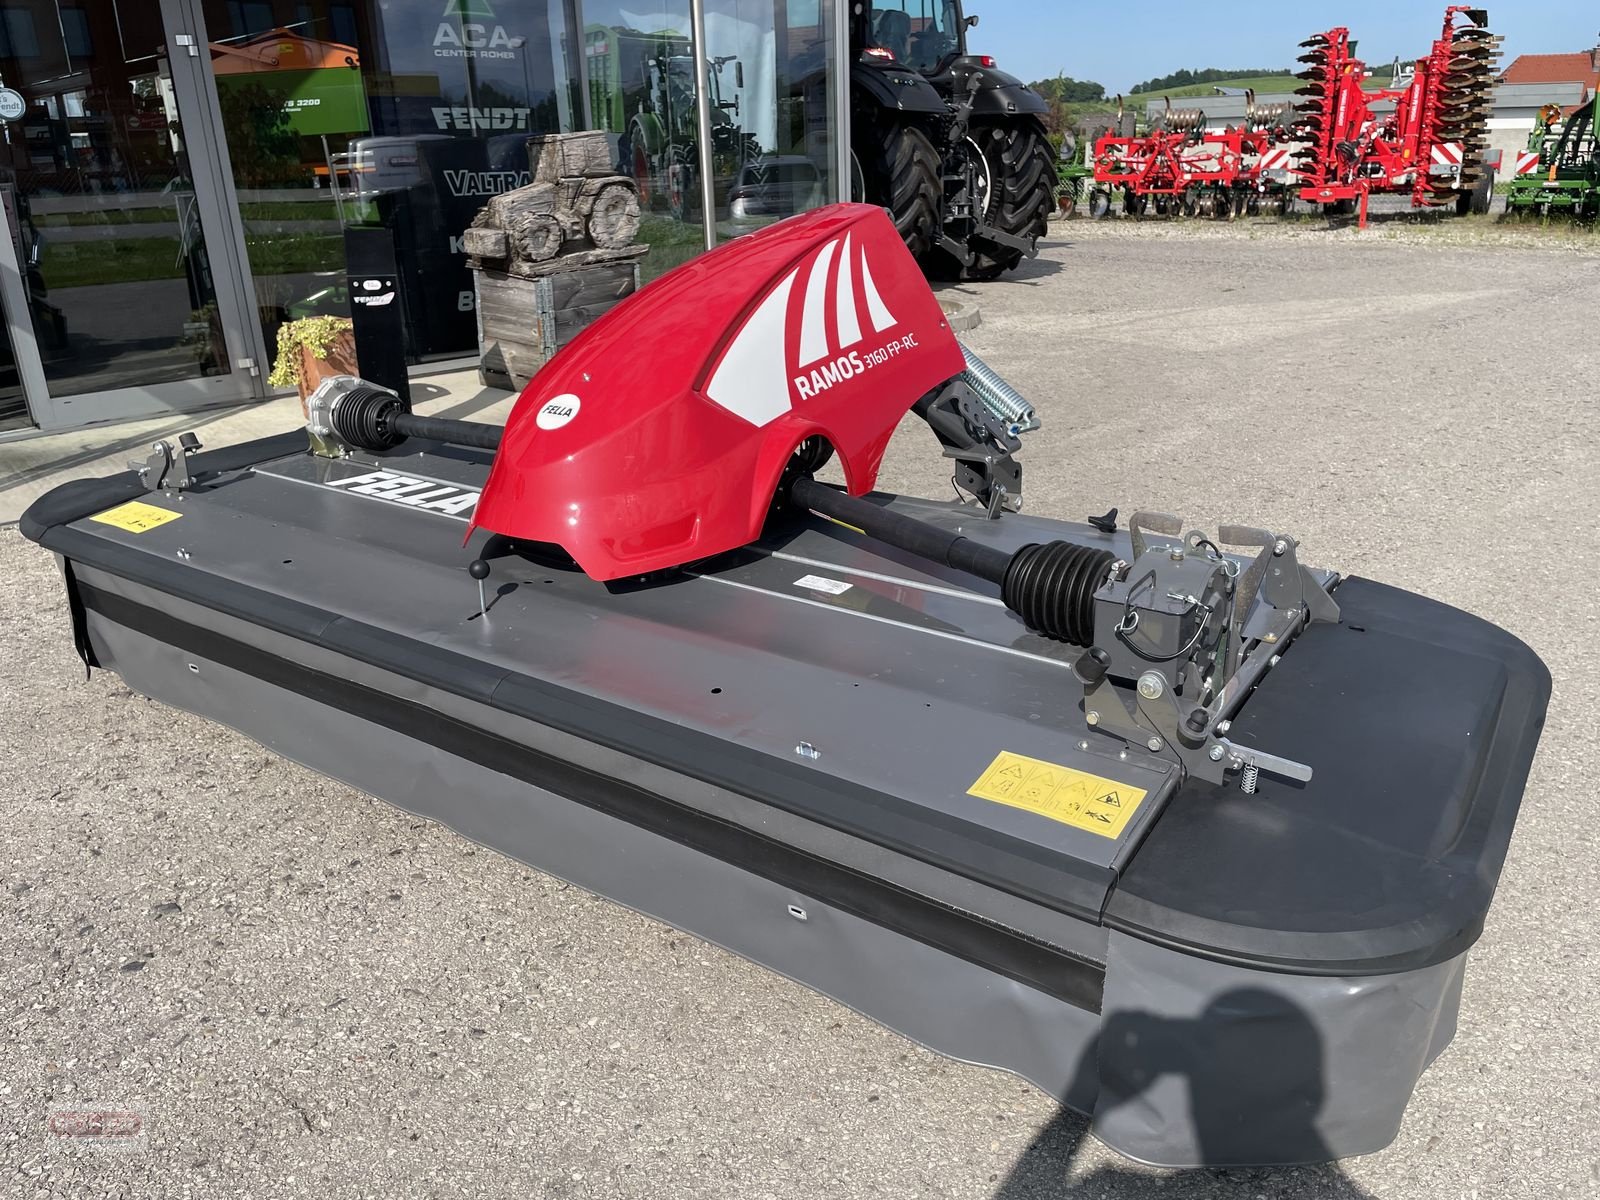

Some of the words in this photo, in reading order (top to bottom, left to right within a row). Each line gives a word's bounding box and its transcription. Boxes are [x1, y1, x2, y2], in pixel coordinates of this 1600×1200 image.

[432, 22, 514, 49] ACA
[434, 49, 477, 58] CENTER
[0, 102, 20, 110] endt
[431, 107, 531, 129] FENDT
[443, 169, 530, 196] VALTRA
[794, 350, 865, 401] RAMOS
[863, 347, 889, 369] 3160
[886, 333, 918, 358] FP-RC
[542, 404, 573, 417] FELLA
[324, 471, 481, 514] FELLA
